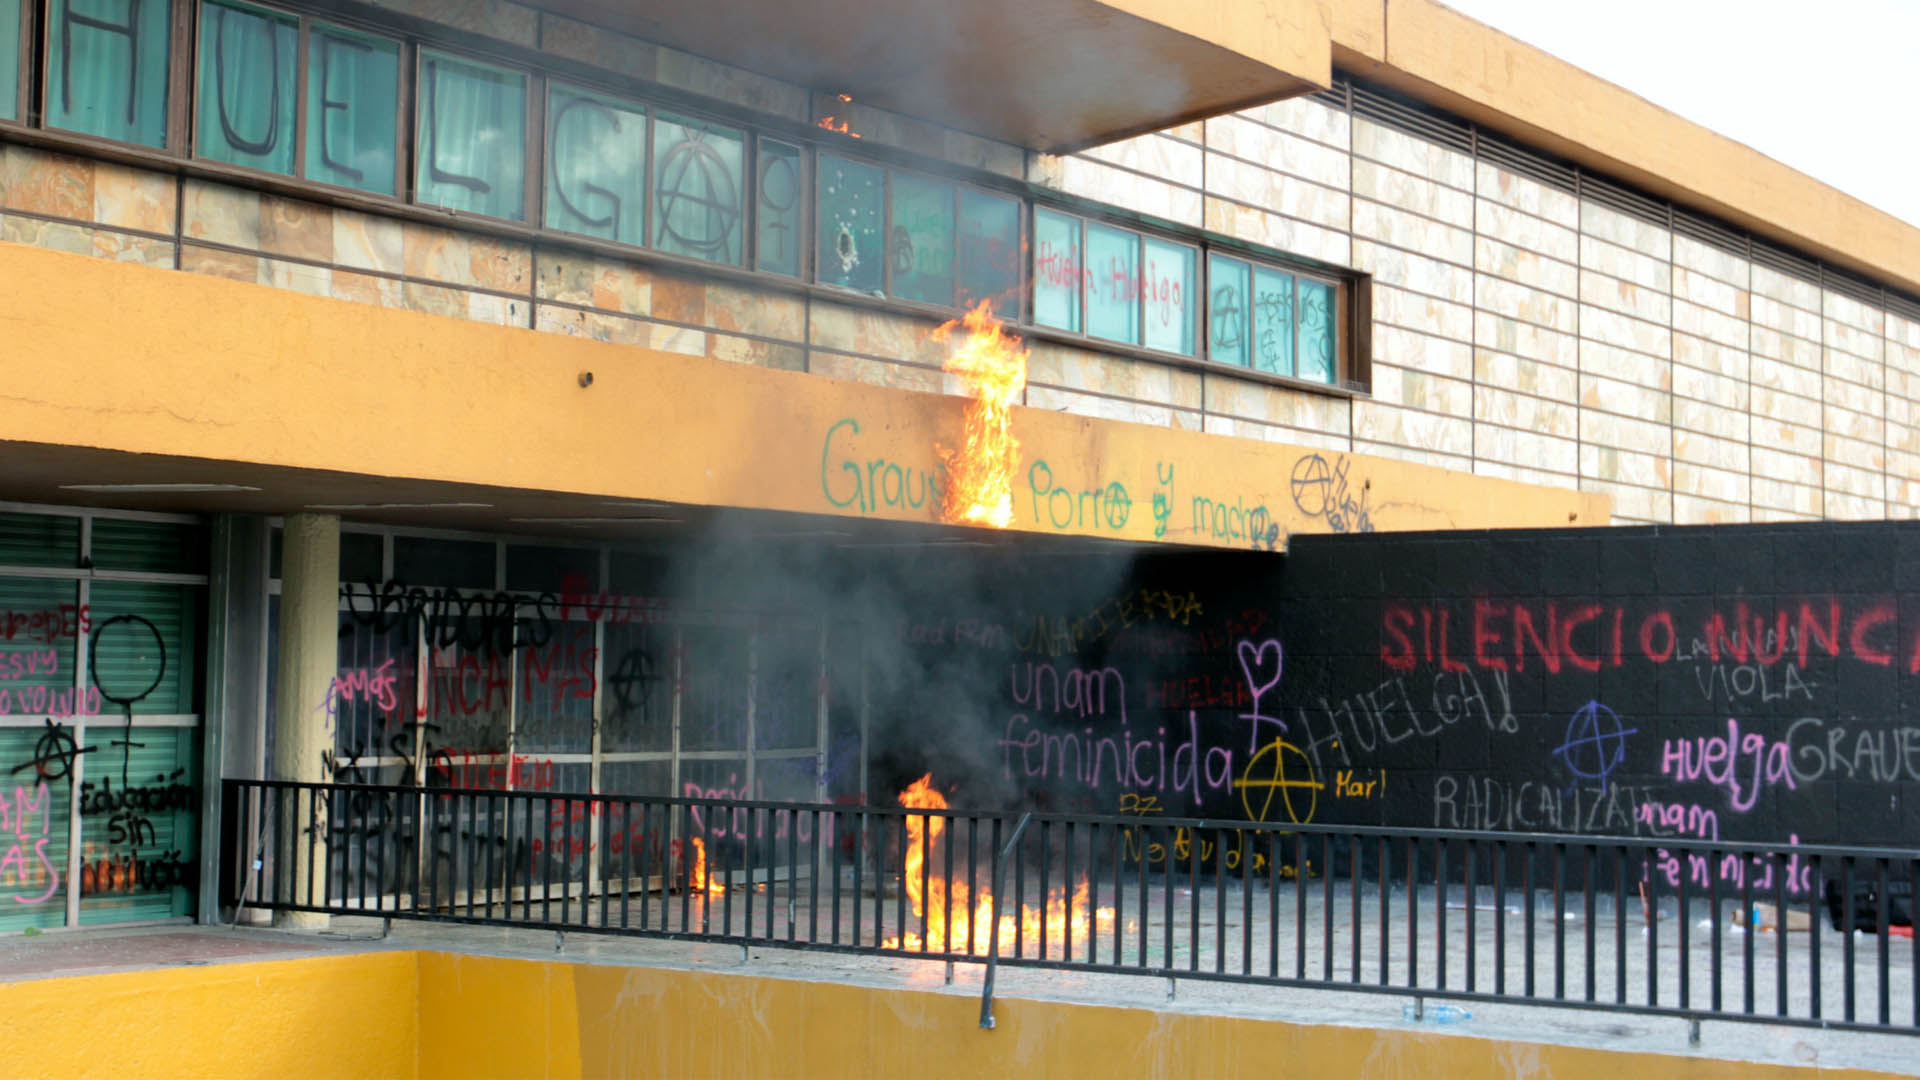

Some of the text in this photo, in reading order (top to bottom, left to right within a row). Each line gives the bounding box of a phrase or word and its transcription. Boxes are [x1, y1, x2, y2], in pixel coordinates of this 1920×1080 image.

[1380, 595, 1676, 673] SILENCIO
[1011, 663, 1128, 724] unam
[1695, 661, 1823, 702] VIOLA
[1000, 712, 1234, 806] feminicida
[1299, 663, 1519, 780] HUELGA!
